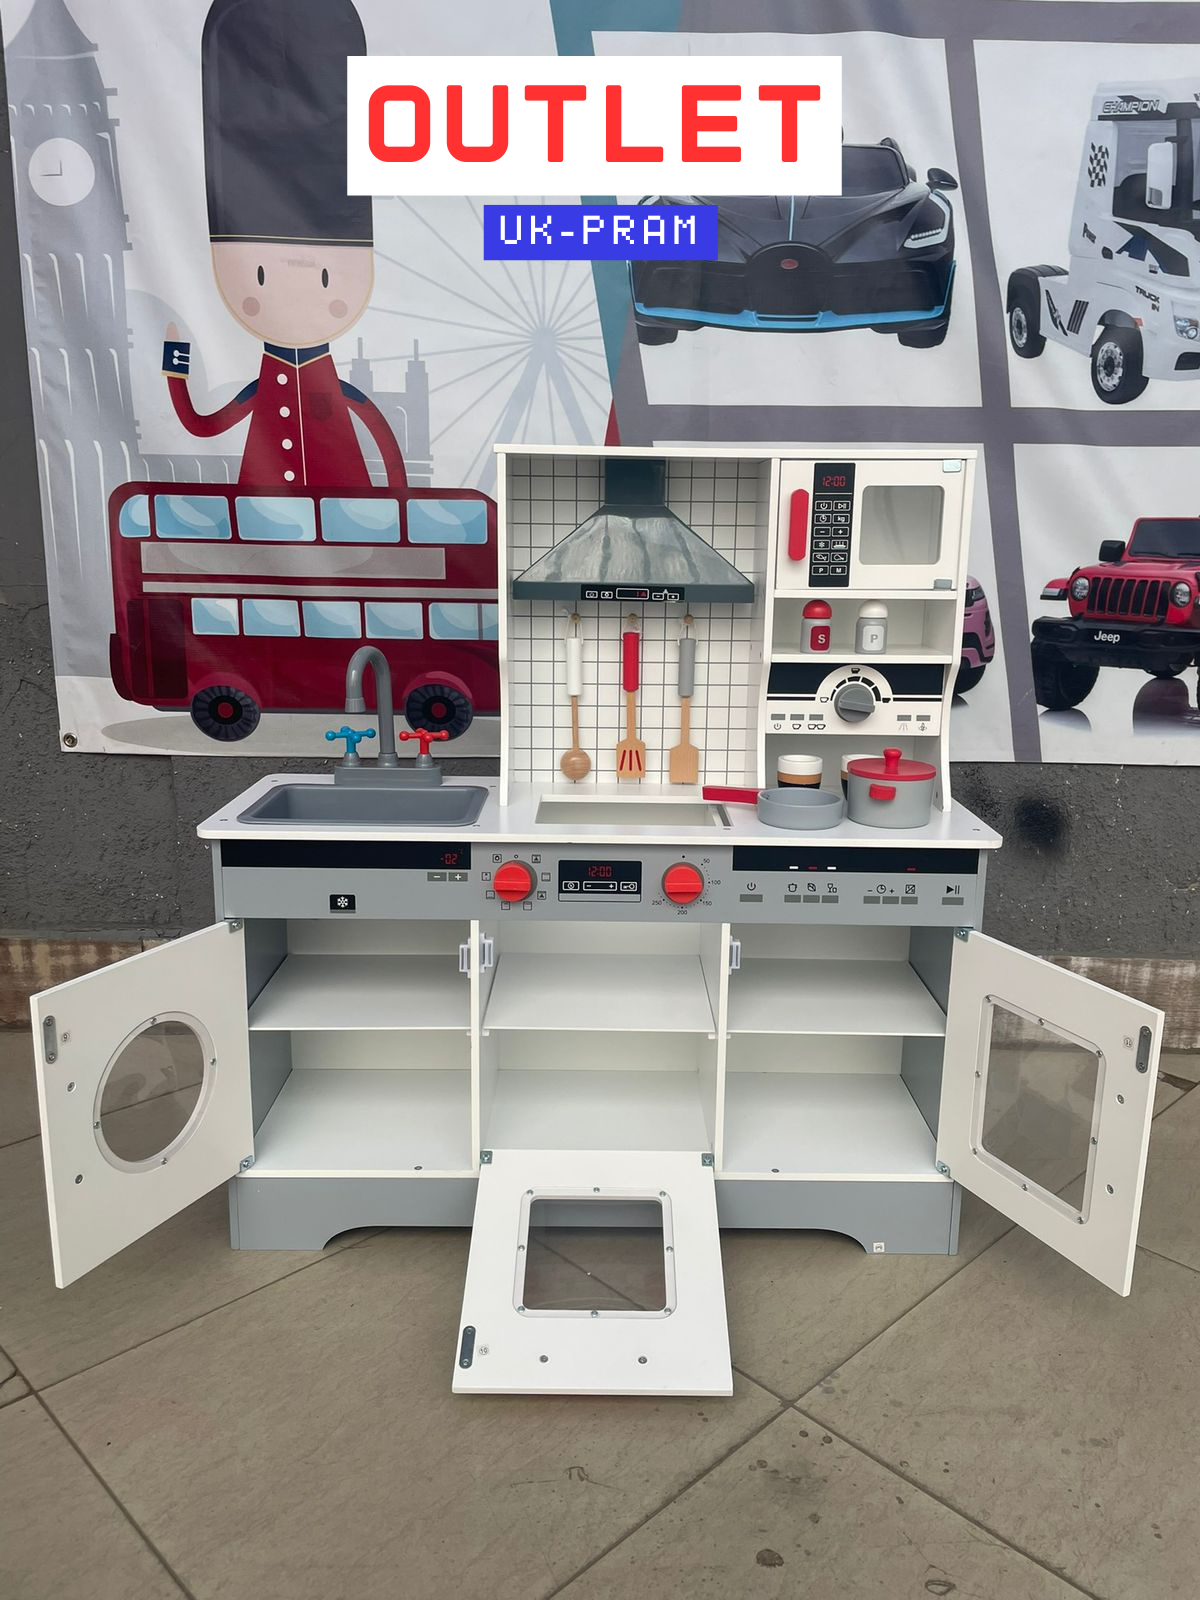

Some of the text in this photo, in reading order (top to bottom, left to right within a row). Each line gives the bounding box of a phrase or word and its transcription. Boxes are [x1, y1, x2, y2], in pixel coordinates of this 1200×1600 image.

[822, 476, 846, 487] 12:00
[817, 634, 826, 644] S
[870, 634, 878, 643] P
[1094, 630, 1120, 643] Jeep
[588, 866, 612, 878] 12:00
